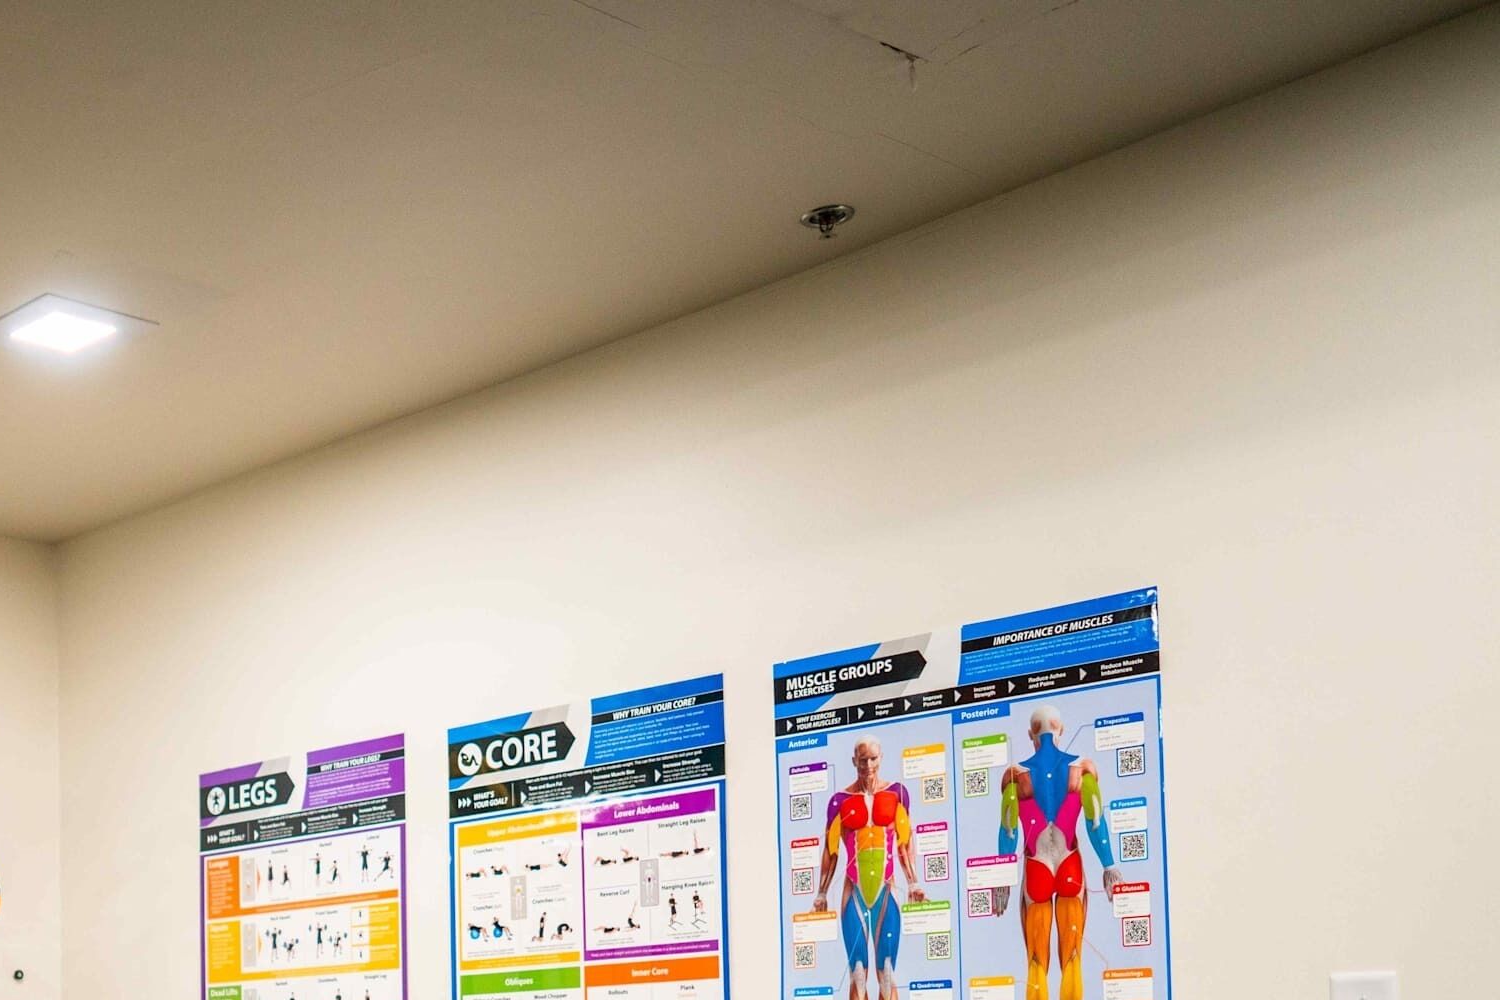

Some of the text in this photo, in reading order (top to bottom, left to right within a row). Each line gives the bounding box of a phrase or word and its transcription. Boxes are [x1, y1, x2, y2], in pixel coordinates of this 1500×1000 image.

[993, 614, 1114, 646] IMPORTANCE OF MUSCLES
[786, 659, 893, 691] MUSCLE GROUPS
[786, 683, 835, 700] & EXERCISES
[612, 697, 697, 721] WHY TRAIN YOUR CORE?
[960, 706, 1000, 721] Posterior
[795, 710, 836, 724] WHY EXERCISE
[812, 717, 842, 730] MUSCLES?
[485, 729, 558, 770] CORE
[788, 737, 818, 749] Anterior
[228, 778, 278, 811] LEGS
[473, 790, 495, 801] WHAT'S
[613, 801, 680, 819] Lower Abdominals
[679, 819, 689, 827] Leg
[631, 967, 669, 977] Inner Core
[504, 978, 534, 987] Obliques
